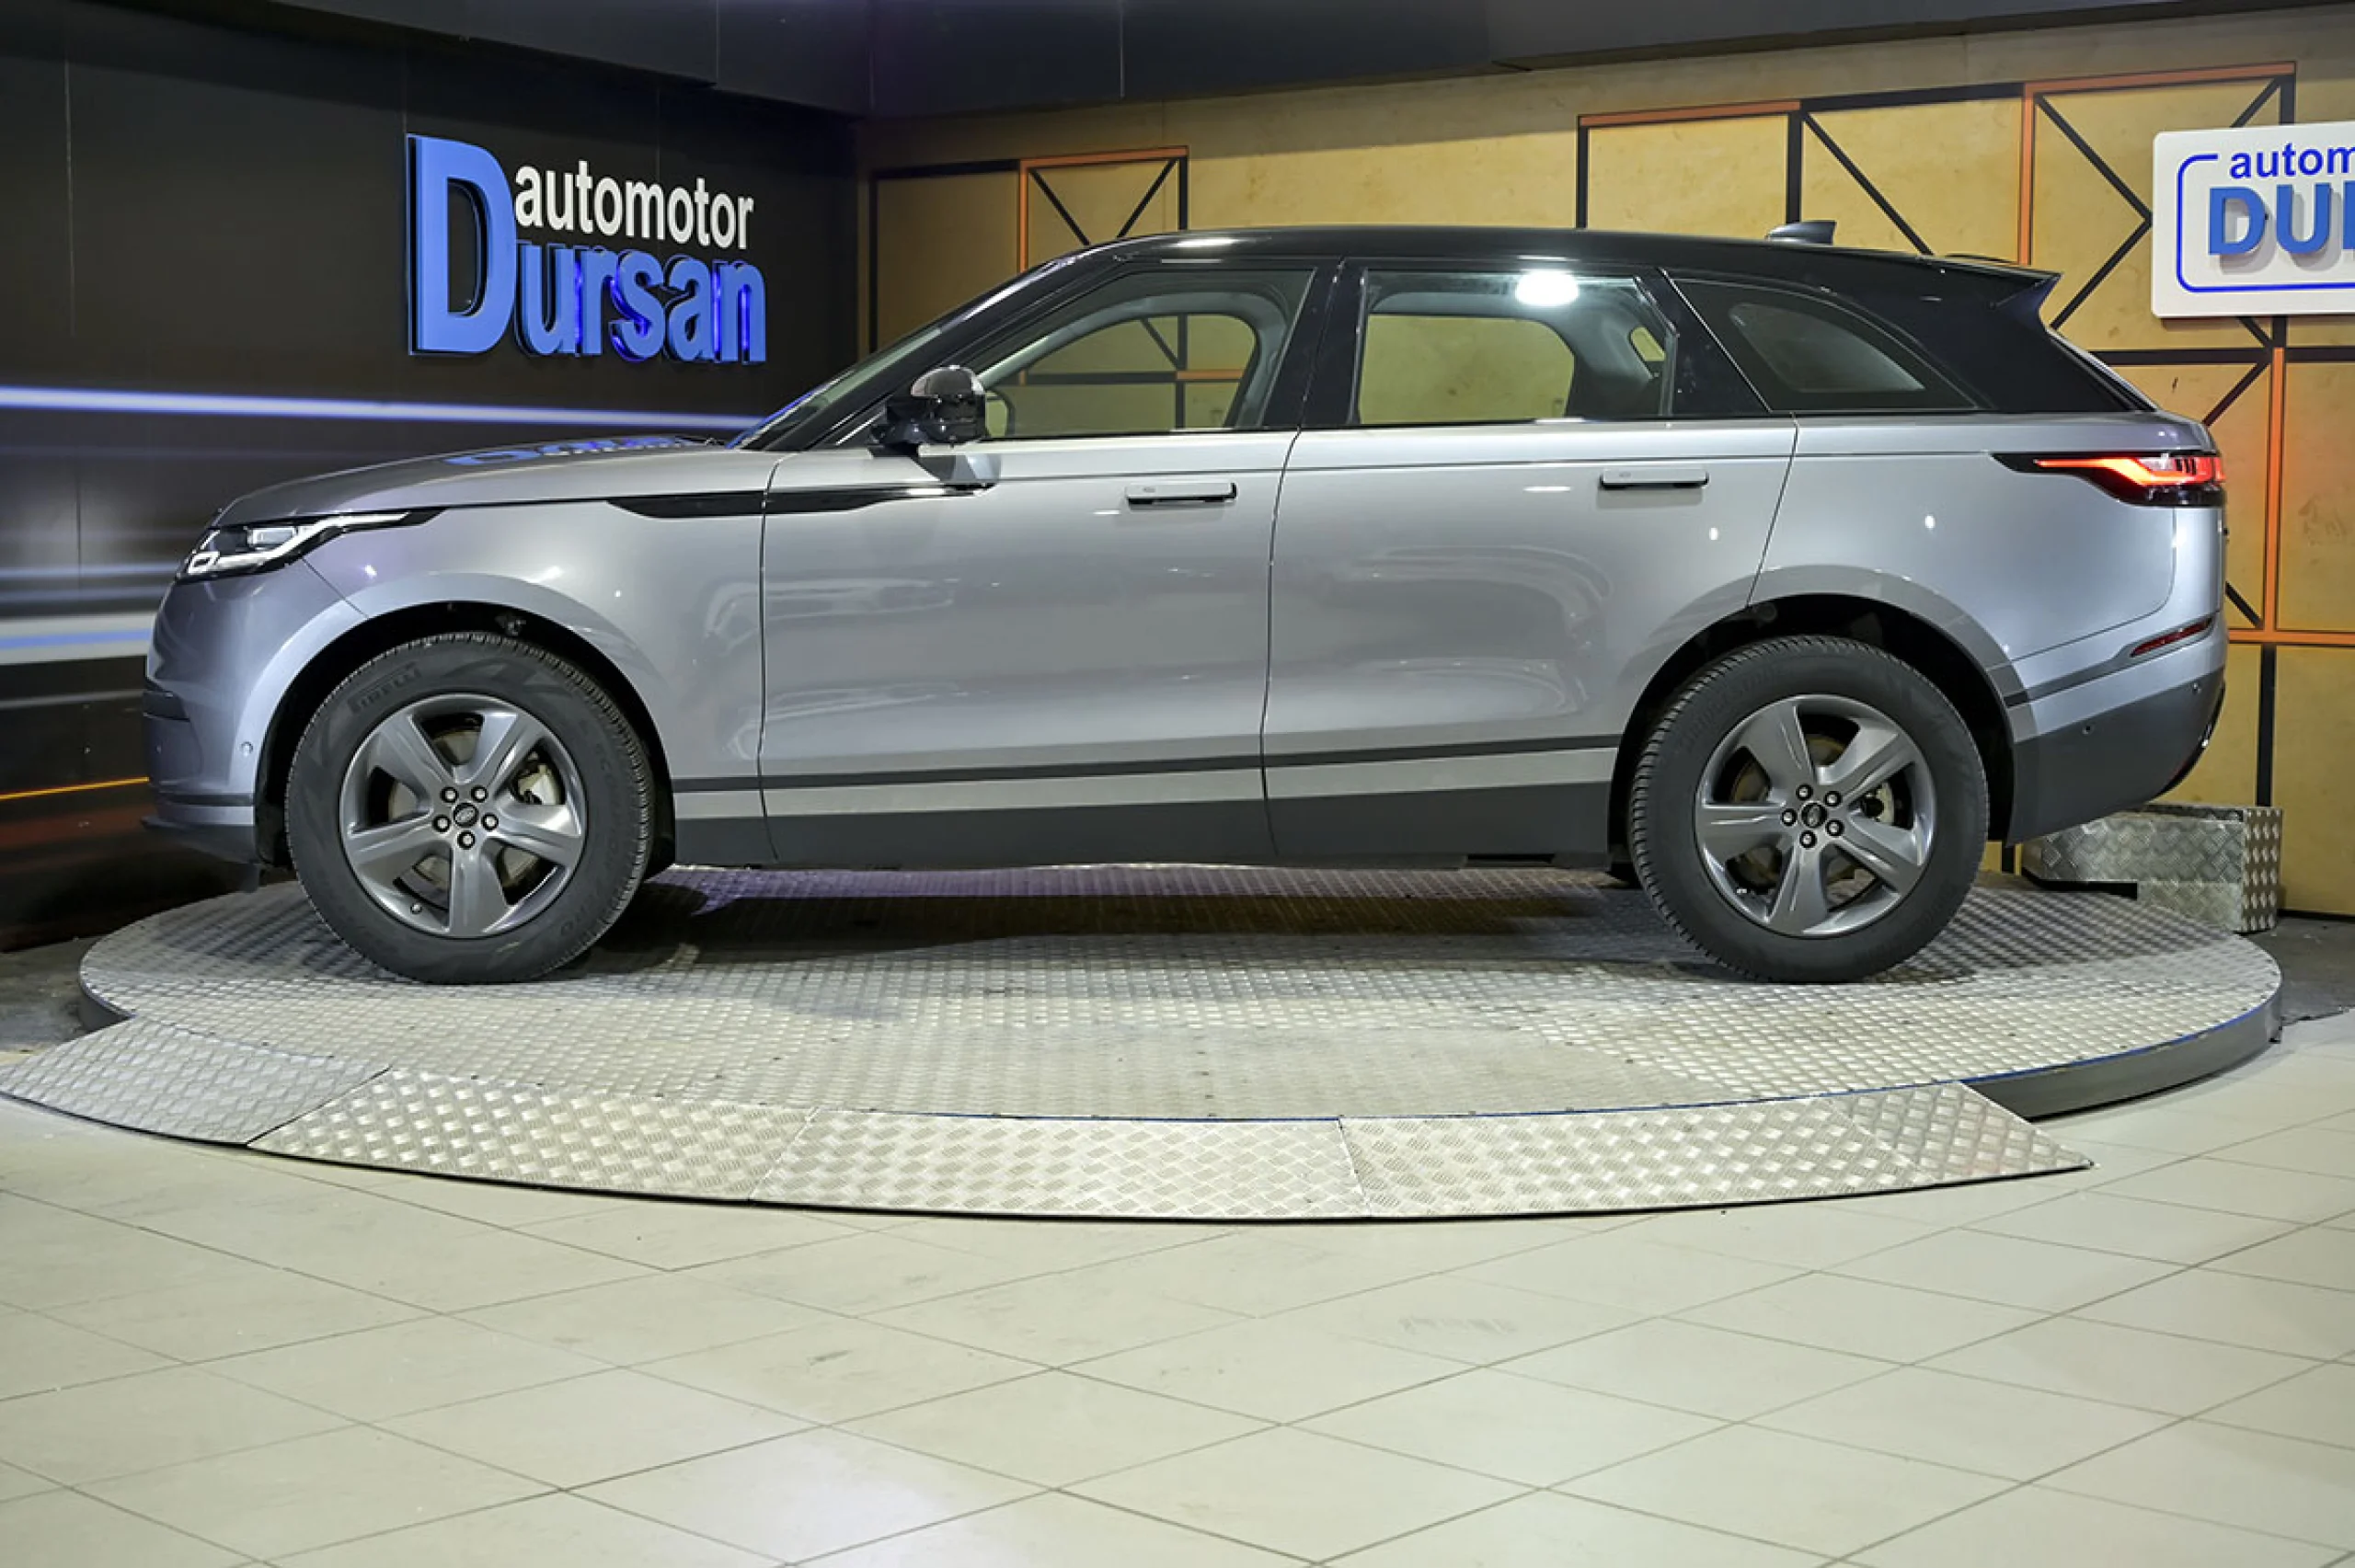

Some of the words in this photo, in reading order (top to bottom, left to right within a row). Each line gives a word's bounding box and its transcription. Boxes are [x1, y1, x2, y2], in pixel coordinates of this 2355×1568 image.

[2230, 143, 2355, 178] autom
[515, 160, 754, 250] automotor
[2209, 181, 2355, 255] DU
[406, 132, 766, 364] Dursan
